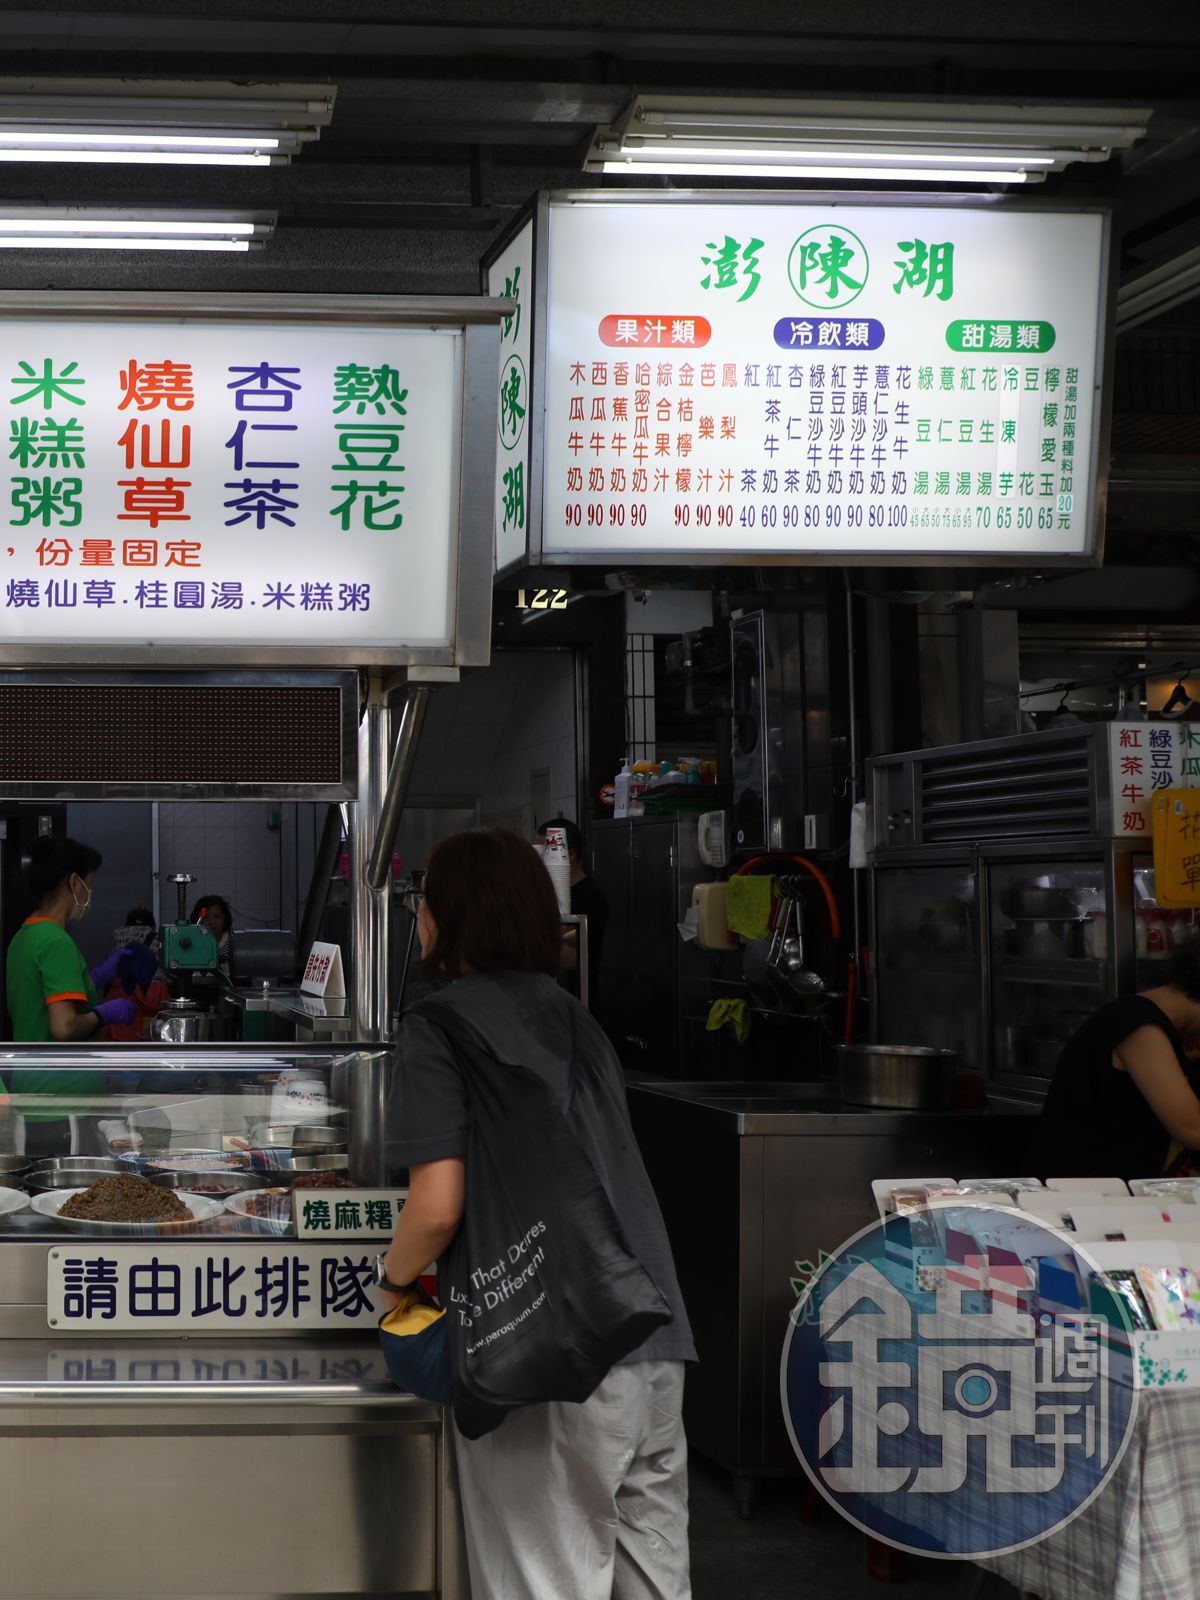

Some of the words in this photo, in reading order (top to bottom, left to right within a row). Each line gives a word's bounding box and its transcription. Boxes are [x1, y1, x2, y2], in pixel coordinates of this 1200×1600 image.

[615, 319, 696, 344] 果汁類
[790, 320, 870, 346] 冷飲類
[962, 323, 1040, 349] 甜湯類
[8, 358, 86, 528] 米糕粥
[117, 358, 195, 528] 燒仙草
[224, 361, 302, 529] 杏仁茶
[330, 361, 409, 532] 熱豆花
[567, 362, 586, 492] 木瓜牛奶
[588, 362, 608, 492] 西瓜牛奶
[610, 362, 629, 492] 香蕉牛奶
[632, 362, 651, 492] 哈密瓜牛奶
[654, 362, 673, 492] 綜合果汁
[675, 362, 695, 492] 金桔檸檬
[697, 362, 716, 493] 芭樂汁
[718, 363, 737, 493] 鳳梨汁
[762, 363, 782, 494] 紅茶牛奶
[784, 364, 804, 493] 杏仁茶
[806, 364, 825, 494] 綠豆沙牛奶
[827, 364, 847, 494] 紅豆沙牛奶
[849, 364, 868, 494] 芋頭沙牛奶
[870, 365, 890, 494] 薏仁沙牛奶
[891, 365, 911, 495] 花生牛奶
[913, 366, 933, 495] 綠豆湯
[935, 366, 955, 495] 薏仁湯
[956, 366, 976, 495] 紅豆湯
[977, 367, 998, 496] 花生湯
[998, 367, 1019, 496] 冷凍芋
[1039, 367, 1061, 497] 檸檬愛玉
[1057, 367, 1078, 530] 甜湯加兩種料加20元
[566, 504, 582, 527] 90
[588, 504, 603, 527] 90
[610, 504, 625, 527] 90
[631, 504, 647, 527] 90
[675, 504, 690, 527] 90
[696, 504, 712, 527] 90
[718, 504, 733, 527] 90
[740, 505, 755, 527] 40
[761, 505, 777, 527] 60
[783, 505, 798, 527] 90
[804, 505, 820, 527] 80
[826, 505, 841, 527] 90
[847, 505, 863, 527] 90
[869, 505, 884, 527] 80
[888, 505, 907, 527] 100
[976, 506, 990, 528] 70
[997, 507, 1011, 529] 65
[1017, 507, 1032, 529] 50
[1038, 507, 1053, 529] 65
[515, 589, 568, 609] 122
[1120, 729, 1145, 831] 紅茶牛奶
[1179, 729, 1200, 788] 木瓜
[303, 1198, 407, 1230] 燒麻糬
[470, 1259, 506, 1290] That
[507, 1221, 546, 1264] Dares
[484, 1246, 545, 1310] Different
[63, 1256, 375, 1319] 請由此排隊
